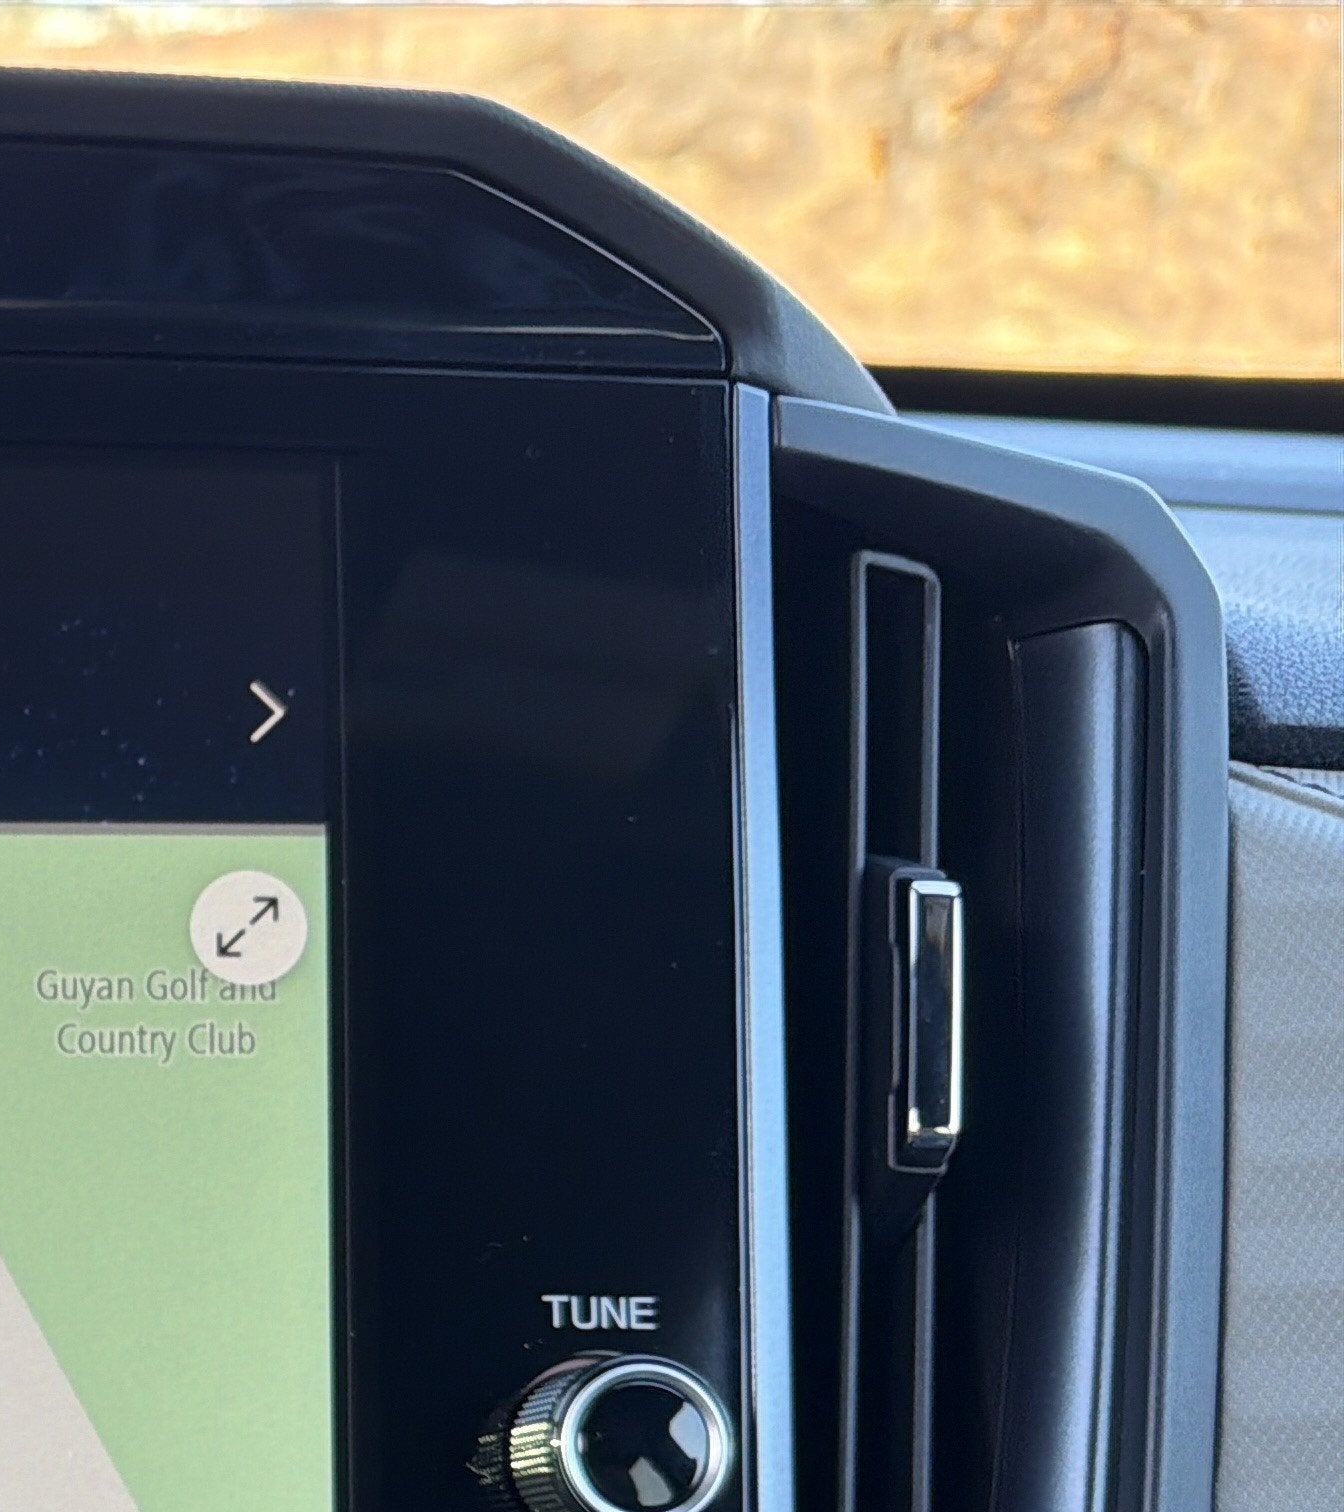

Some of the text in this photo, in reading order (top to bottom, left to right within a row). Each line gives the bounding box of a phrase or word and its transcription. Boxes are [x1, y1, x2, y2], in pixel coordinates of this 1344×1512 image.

[36, 969, 135, 1010] Guyan
[146, 968, 209, 1001] Golf
[57, 1022, 256, 1064] Country Club
[541, 1294, 660, 1330] TUNE
